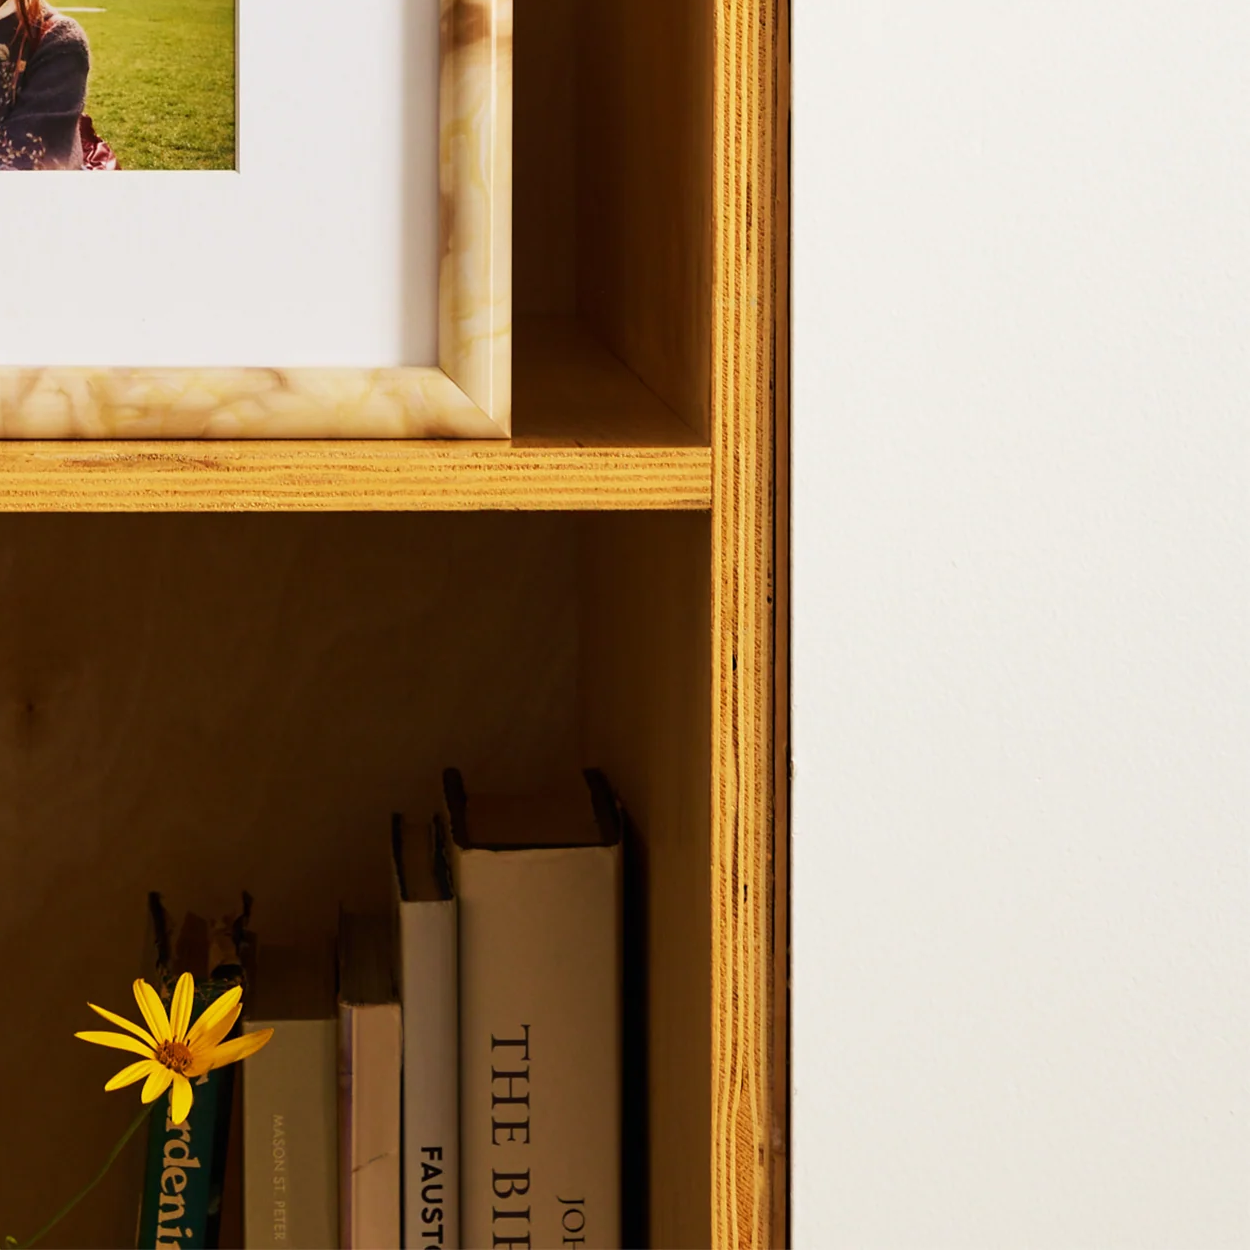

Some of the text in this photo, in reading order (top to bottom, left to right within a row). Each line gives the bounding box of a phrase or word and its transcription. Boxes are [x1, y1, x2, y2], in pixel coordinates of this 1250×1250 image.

[491, 1024, 531, 1146] THE
[155, 1071, 209, 1250] rdeni
[272, 1114, 286, 1172] MASON
[273, 1200, 287, 1240] PETER
[420, 1146, 444, 1250] FAUST
